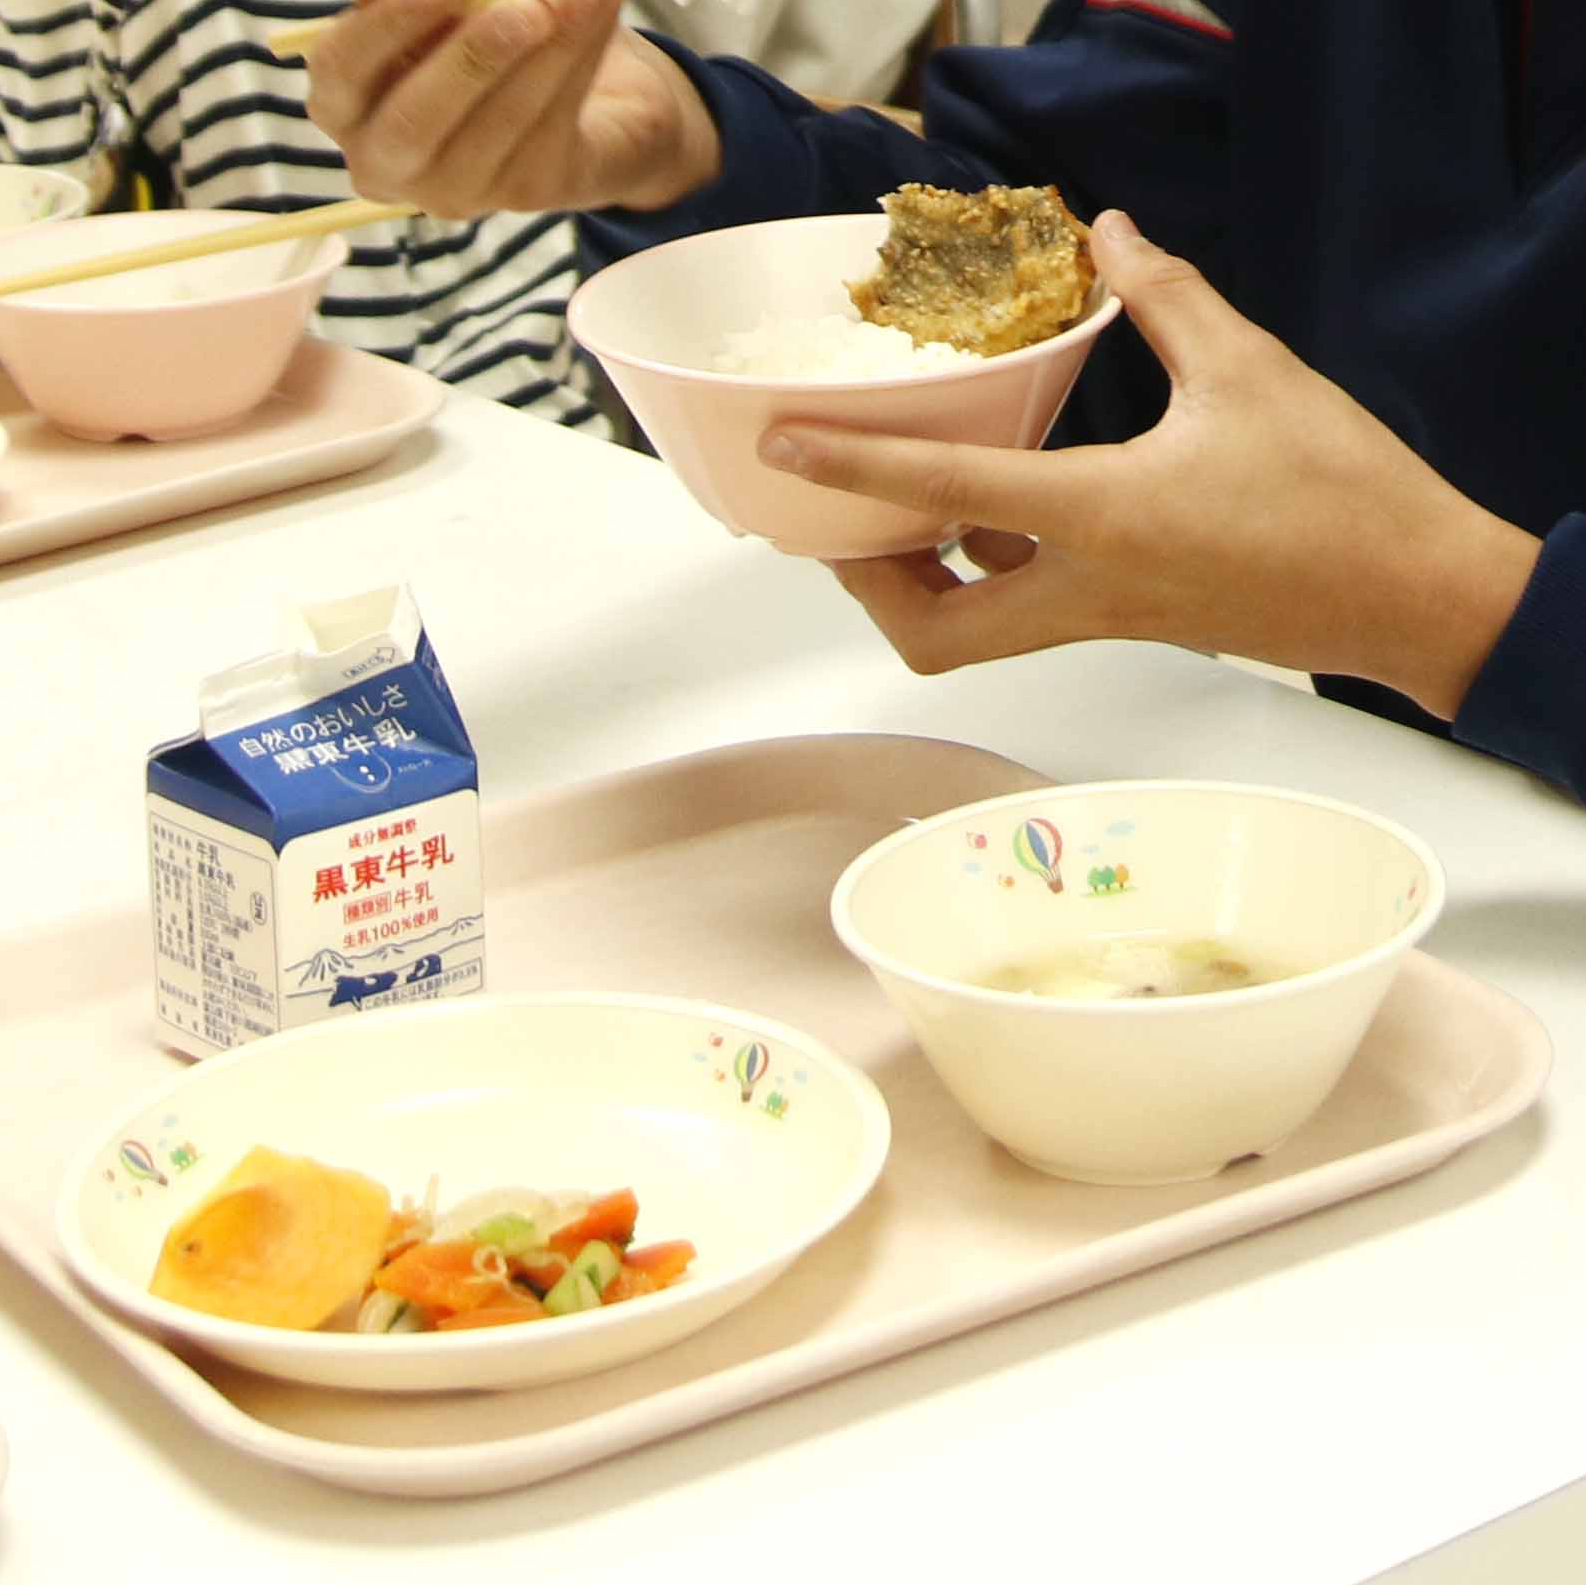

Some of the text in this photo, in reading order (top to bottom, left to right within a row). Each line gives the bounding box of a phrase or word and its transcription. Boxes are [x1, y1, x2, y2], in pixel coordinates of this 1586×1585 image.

[239, 683, 408, 758] 自然のおいしさ
[274, 717, 416, 775] 黒東牛乳
[349, 818, 417, 849] 成分無調整
[313, 833, 455, 904] 黒東牛乳
[344, 907, 439, 948] 生乳100%使用
